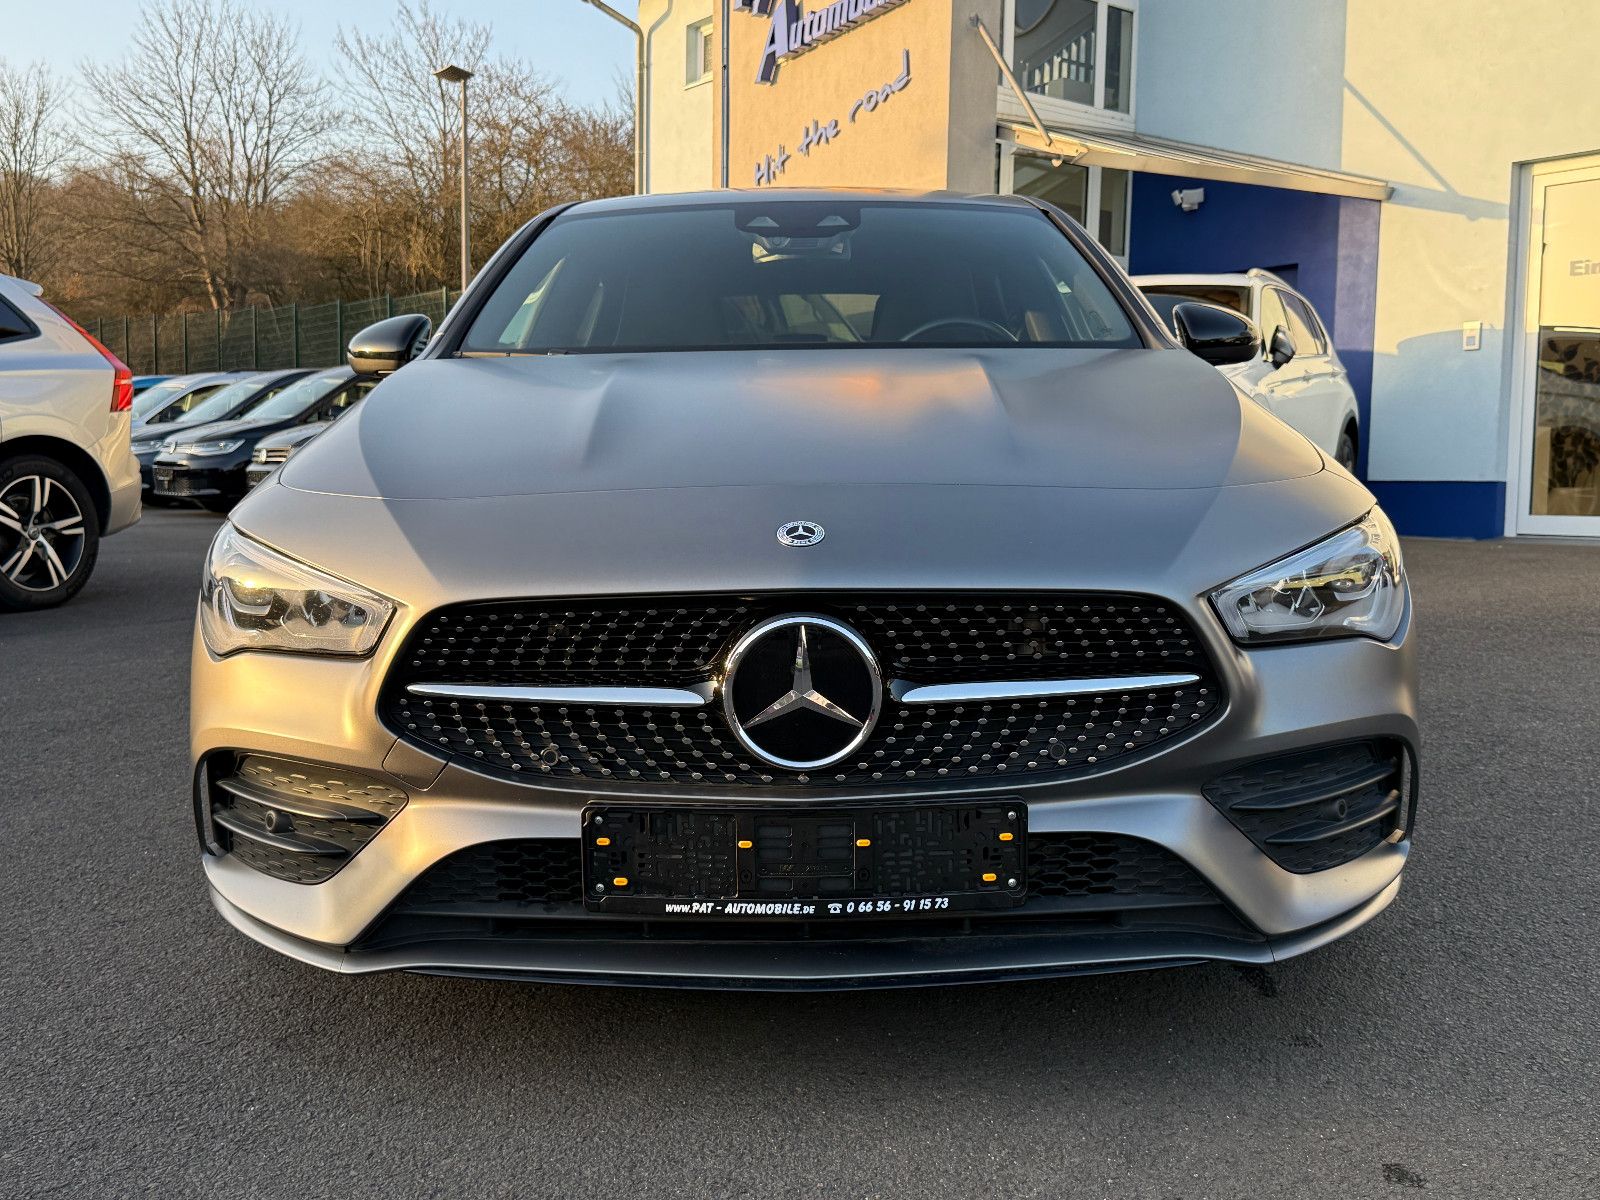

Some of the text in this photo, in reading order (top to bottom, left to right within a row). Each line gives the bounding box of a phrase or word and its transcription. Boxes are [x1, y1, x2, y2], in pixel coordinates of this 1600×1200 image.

[754, 0, 894, 84] Automo
[754, 48, 912, 187] Hit the road
[724, 902, 816, 915] AUTOMOBILE.DE
[846, 901, 855, 913] 0
[858, 901, 873, 913] 66
[876, 900, 892, 912] 56
[903, 899, 916, 912] 91
[919, 898, 932, 910] 15
[934, 897, 949, 909] 73
